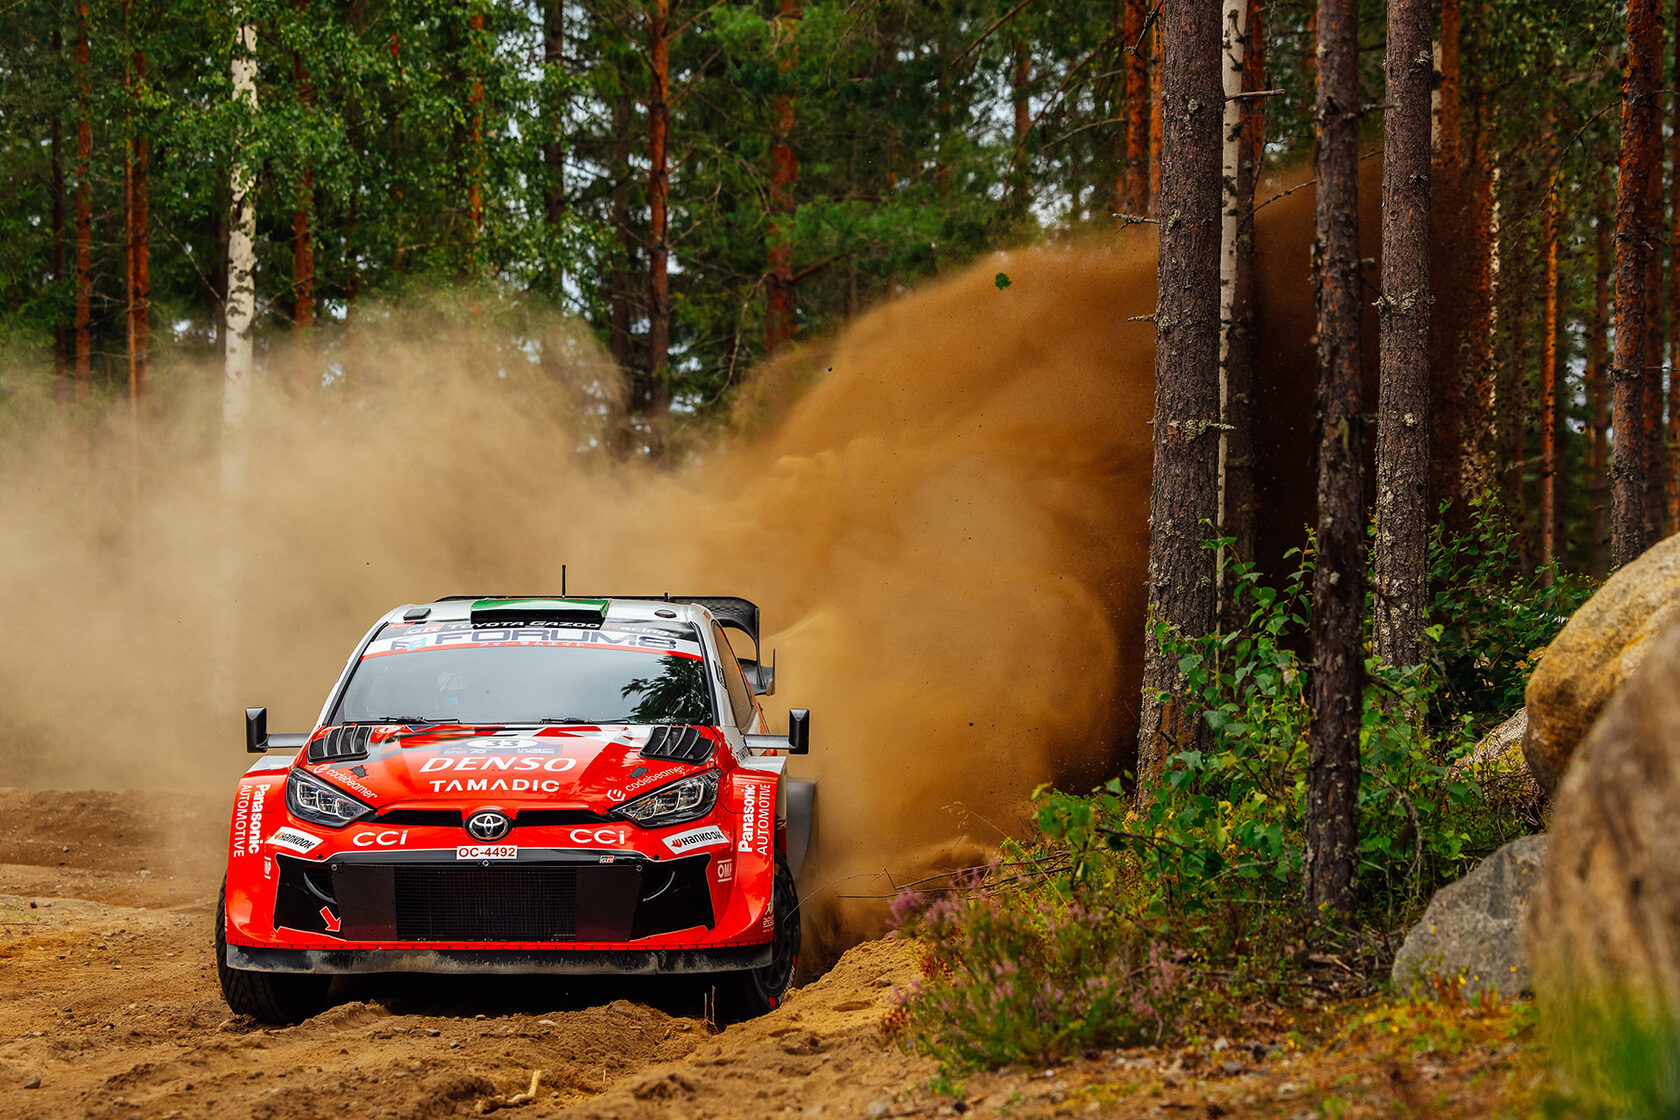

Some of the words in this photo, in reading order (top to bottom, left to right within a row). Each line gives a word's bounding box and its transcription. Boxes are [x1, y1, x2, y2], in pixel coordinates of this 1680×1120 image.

[447, 621, 524, 630] TOYOTA
[529, 620, 600, 628] GAZOO
[435, 629, 677, 650] FORUM8
[485, 739, 520, 747] 33
[419, 756, 577, 772] DENSO
[326, 769, 377, 799] codebeamer
[429, 779, 560, 792] TAMADIC
[625, 765, 686, 791] codebeamer
[233, 784, 253, 858] AUTOMOTIVE
[248, 783, 271, 854] Panasonic
[738, 784, 756, 852] Panasonic
[757, 784, 771, 856] AUTOMOTIVE
[458, 847, 516, 858] OC-4492
